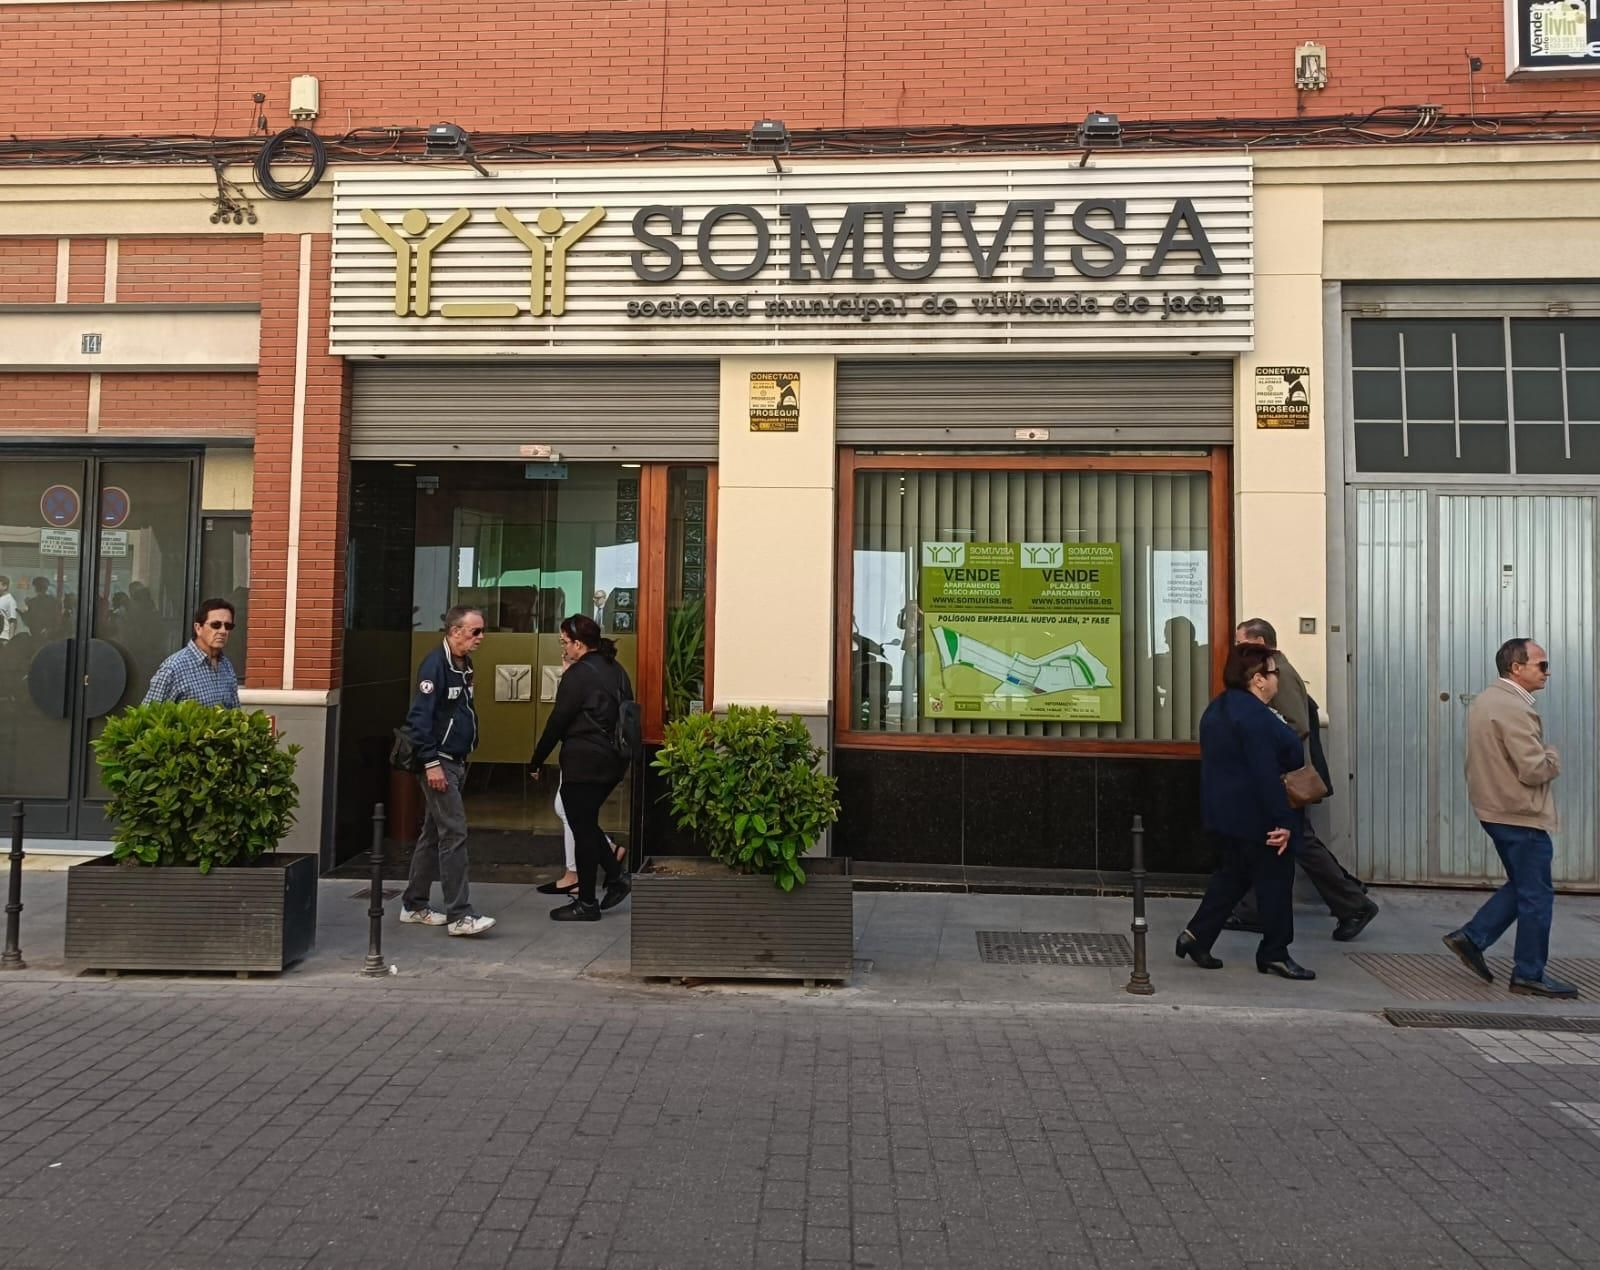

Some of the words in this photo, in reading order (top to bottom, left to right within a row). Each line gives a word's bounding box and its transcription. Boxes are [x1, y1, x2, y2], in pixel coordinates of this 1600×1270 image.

[1531, 11, 1543, 54] Vende
[631, 198, 1222, 282] SOMUVISA
[627, 295, 749, 317] sociedad
[765, 292, 908, 321] municipal
[922, 292, 957, 315] de
[972, 290, 1099, 314] vivienda
[1113, 291, 1150, 314] de
[1161, 288, 1225, 320] jaén
[85, 335, 97, 352] 14
[1256, 367, 1309, 375] CONECTADA
[1257, 405, 1308, 413] PROSEGUR
[969, 546, 1014, 555] SOMUVISA
[1068, 547, 1113, 555] SOMUVISA
[944, 568, 1000, 582] VENDE
[1042, 569, 1099, 583] VENDE
[932, 596, 1012, 604] www.somuvisa.es
[937, 614, 977, 623] POLÍGONO
[977, 615, 1029, 624] EMPRESARIAL
[1031, 616, 1057, 624] NUEVO
[1091, 617, 1110, 625] FASE
